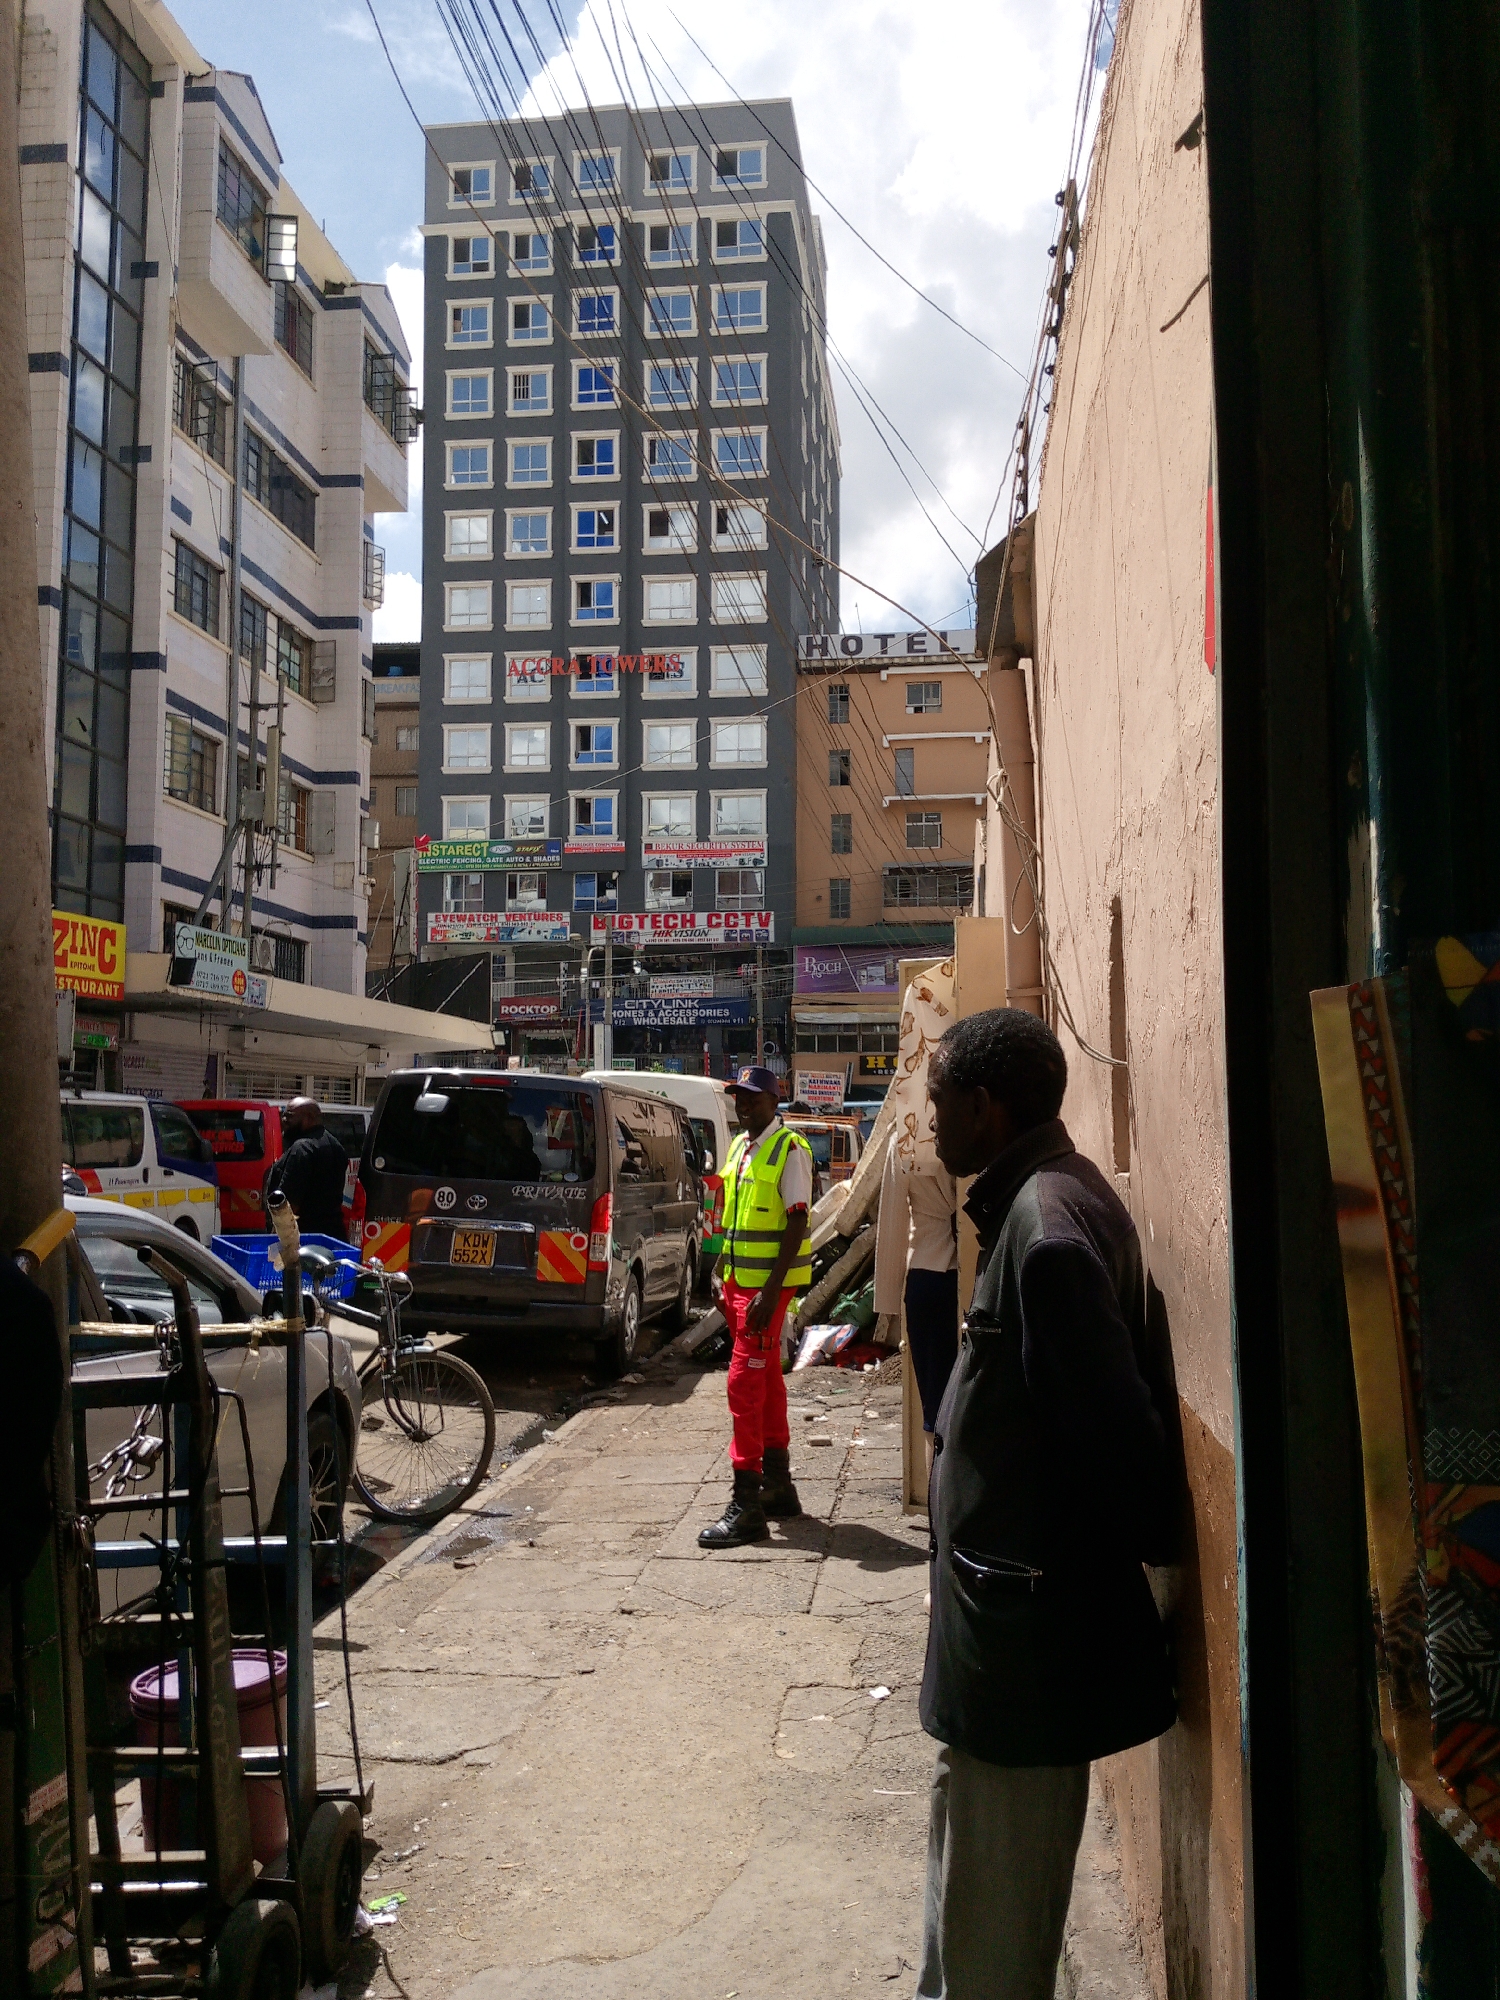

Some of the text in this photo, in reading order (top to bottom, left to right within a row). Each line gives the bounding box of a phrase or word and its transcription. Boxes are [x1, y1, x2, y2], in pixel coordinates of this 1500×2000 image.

[805, 631, 960, 657] HOTEL
[507, 653, 681, 677] ACCRA TOWERS
[686, 841, 729, 850] SECURITY
[730, 840, 764, 849] SYSTEM
[435, 913, 563, 923] EYEWATCH VENTURES
[593, 912, 772, 930] BIGTECH CCTV
[653, 929, 711, 938] HIKVISION
[52, 918, 117, 975] ZINC
[222, 938, 246, 957] OPTICIANS
[70, 960, 95, 972] EPITOME
[501, 1005, 558, 1014] ROCKTOP
[625, 1000, 700, 1009] CITYLINK
[648, 1009, 655, 1017] &
[658, 1009, 730, 1017] ACCESSORIES
[633, 1016, 696, 1025] WHOLESALE
[437, 1191, 454, 1203] 80
[512, 1185, 587, 1200] PRIVATE
[463, 1233, 490, 1248] KDW
[454, 1249, 487, 1265] 552X
